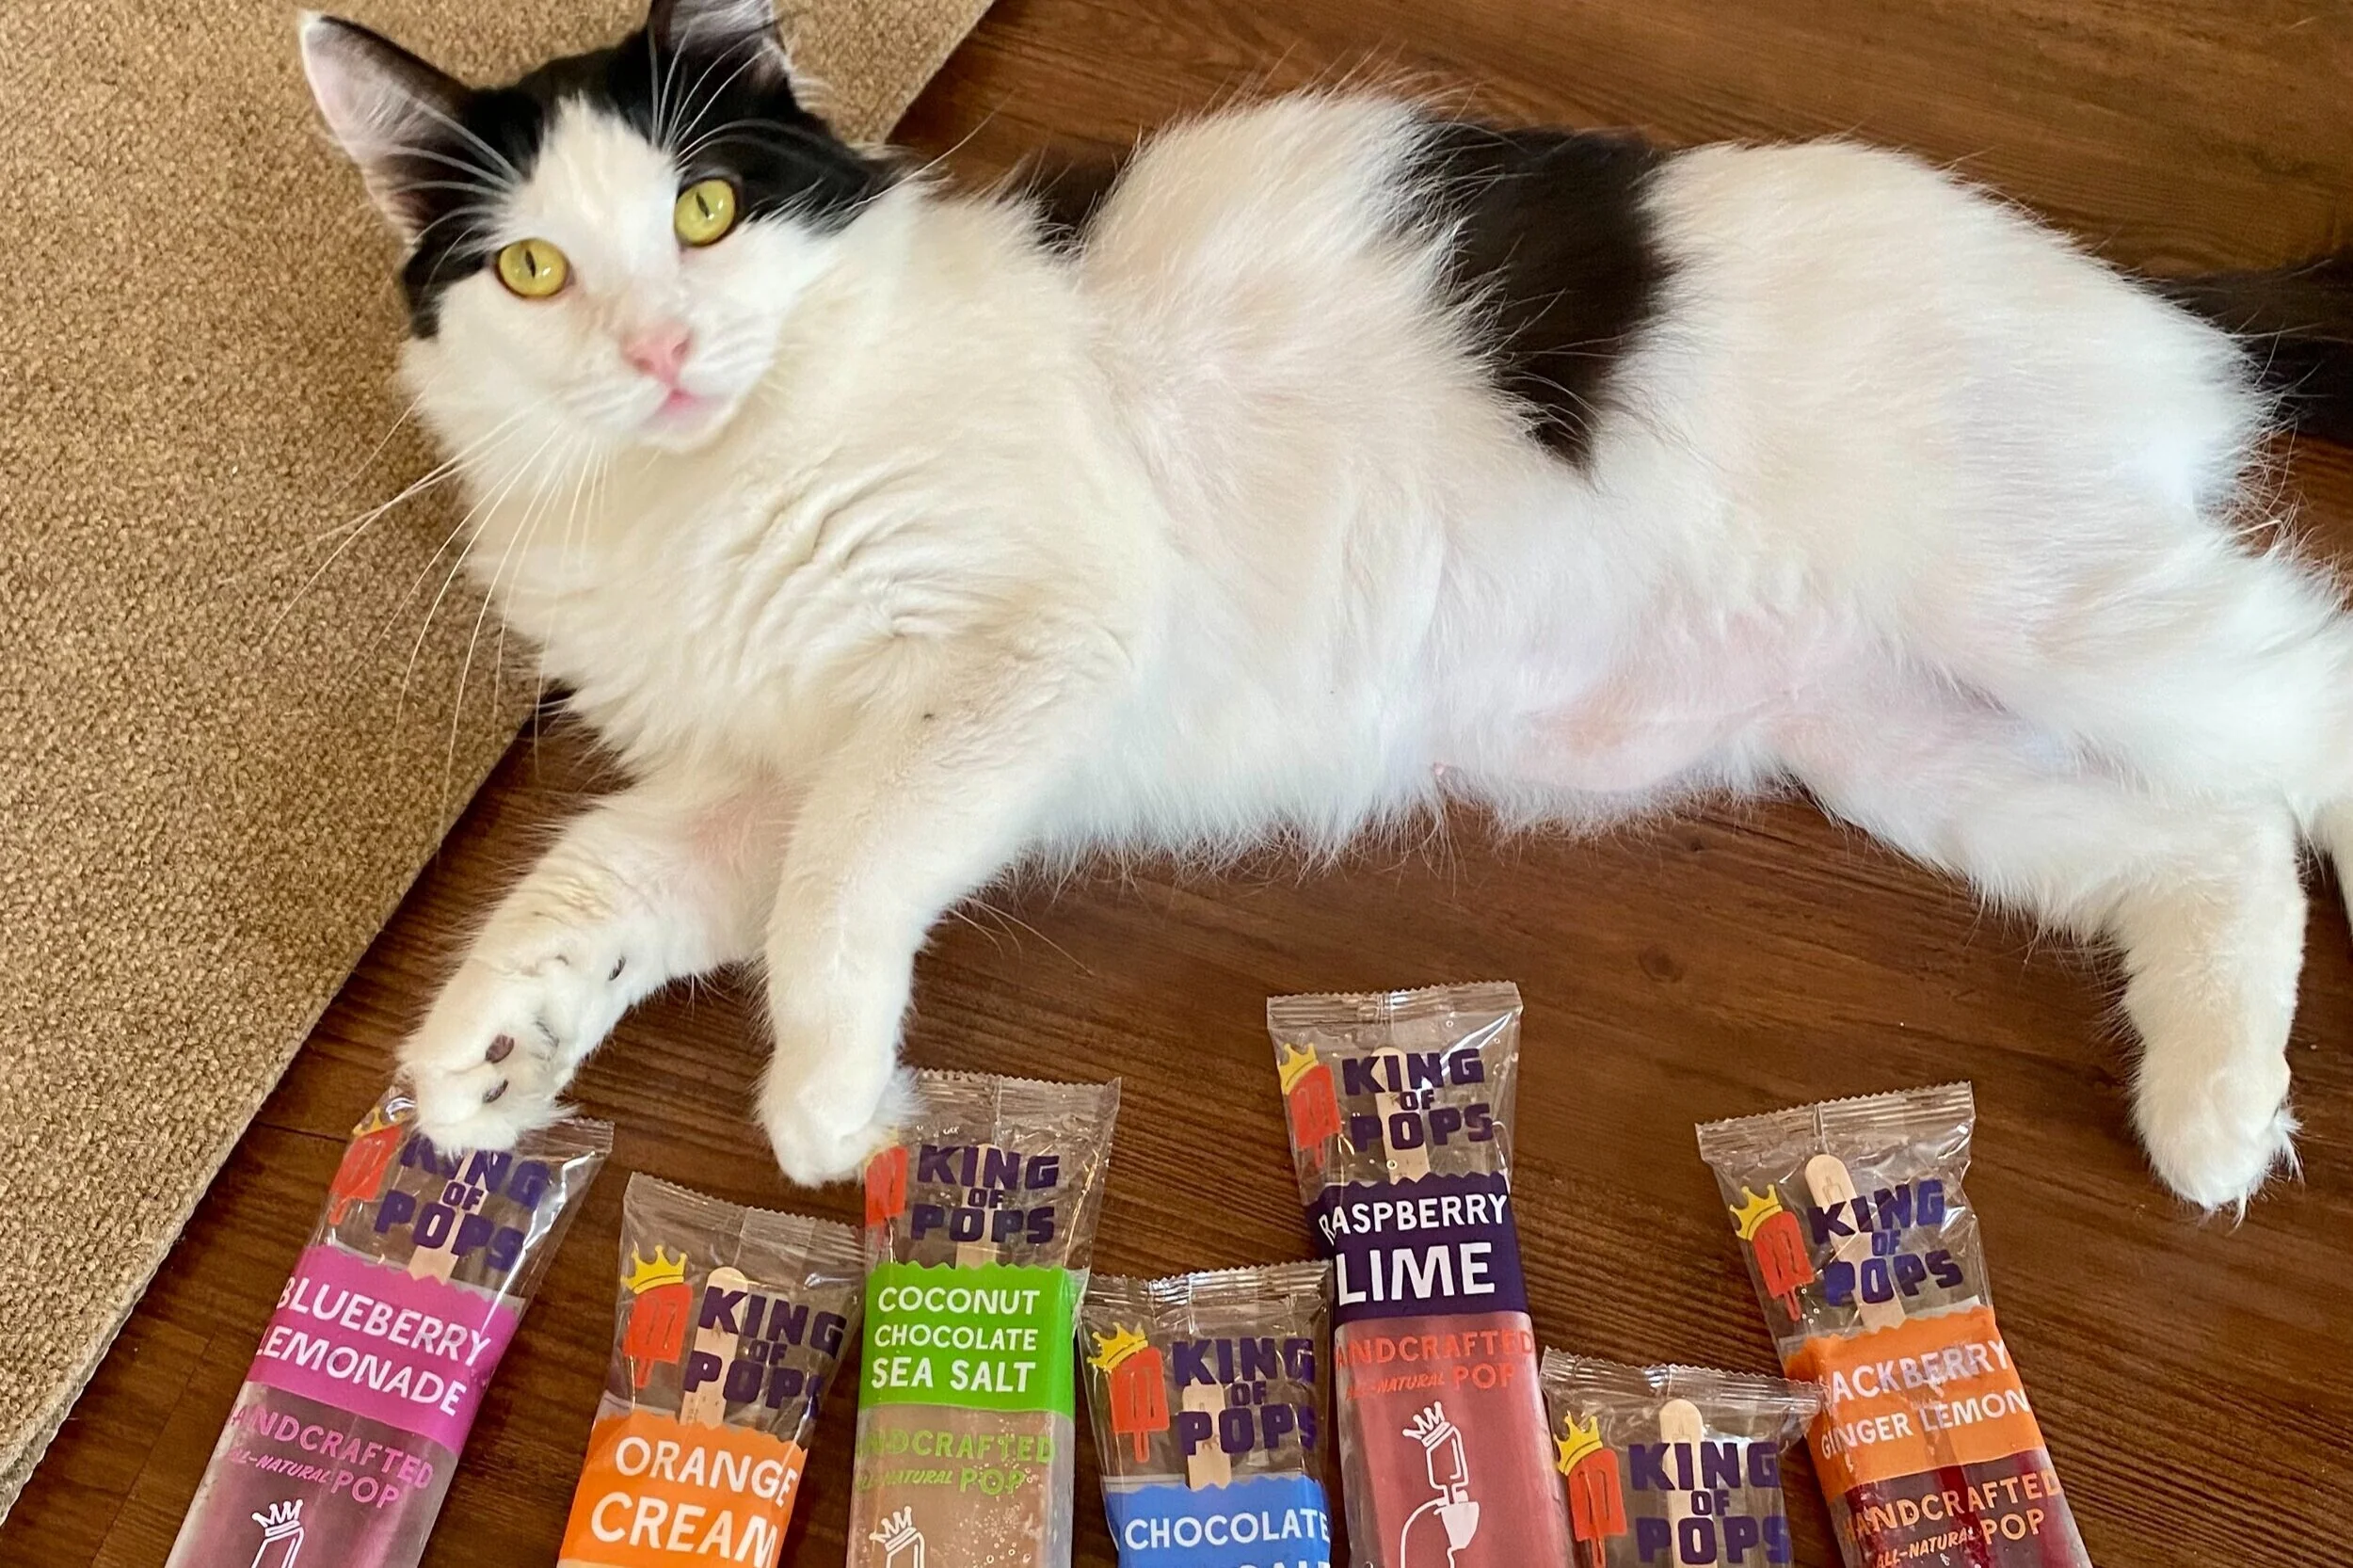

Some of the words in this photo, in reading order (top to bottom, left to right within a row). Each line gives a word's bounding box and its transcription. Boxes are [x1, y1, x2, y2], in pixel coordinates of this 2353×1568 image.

[1342, 1048, 1484, 1096] KING
[1400, 1089, 1435, 1112] OF
[1350, 1103, 1494, 1153] POPS
[917, 1144, 1060, 1191] KING
[442, 1181, 485, 1211] OF
[967, 1187, 1004, 1208] OF
[1319, 1193, 1508, 1246] RASPBERRY
[1807, 1178, 1945, 1244] KING
[374, 1189, 525, 1272] POPS
[910, 1203, 1055, 1244] POPS
[1871, 1228, 1901, 1256] OF
[1336, 1241, 1496, 1306] LIME
[1823, 1249, 1964, 1306] POPS
[276, 1276, 490, 1367] BLUEBERRY
[698, 1286, 847, 1360] KING
[877, 1286, 1040, 1315] COCONUT
[749, 1338, 788, 1367] OF
[873, 1324, 1038, 1352] CHOCOLATE
[1173, 1336, 1316, 1386] KING
[871, 1356, 934, 1389] SEA
[950, 1359, 1036, 1393] SALT
[1230, 1381, 1268, 1406] OF
[1453, 1363, 1516, 1391] POP
[1819, 1339, 2011, 1403] ACKBERRY
[1821, 1413, 1913, 1460] GINGER
[1919, 1388, 2030, 1432] LEMON
[330, 1470, 400, 1510] POP
[616, 1436, 798, 1508] ORANGE
[959, 1467, 1027, 1496] POP
[1627, 1442, 1781, 1491] KING
[1691, 1490, 1730, 1516] OF
[1980, 1508, 2046, 1544] POP
[591, 1492, 778, 1568] CREAM
[1124, 1508, 1331, 1550] CHOCOLATE
[1635, 1515, 1792, 1565] POPS
